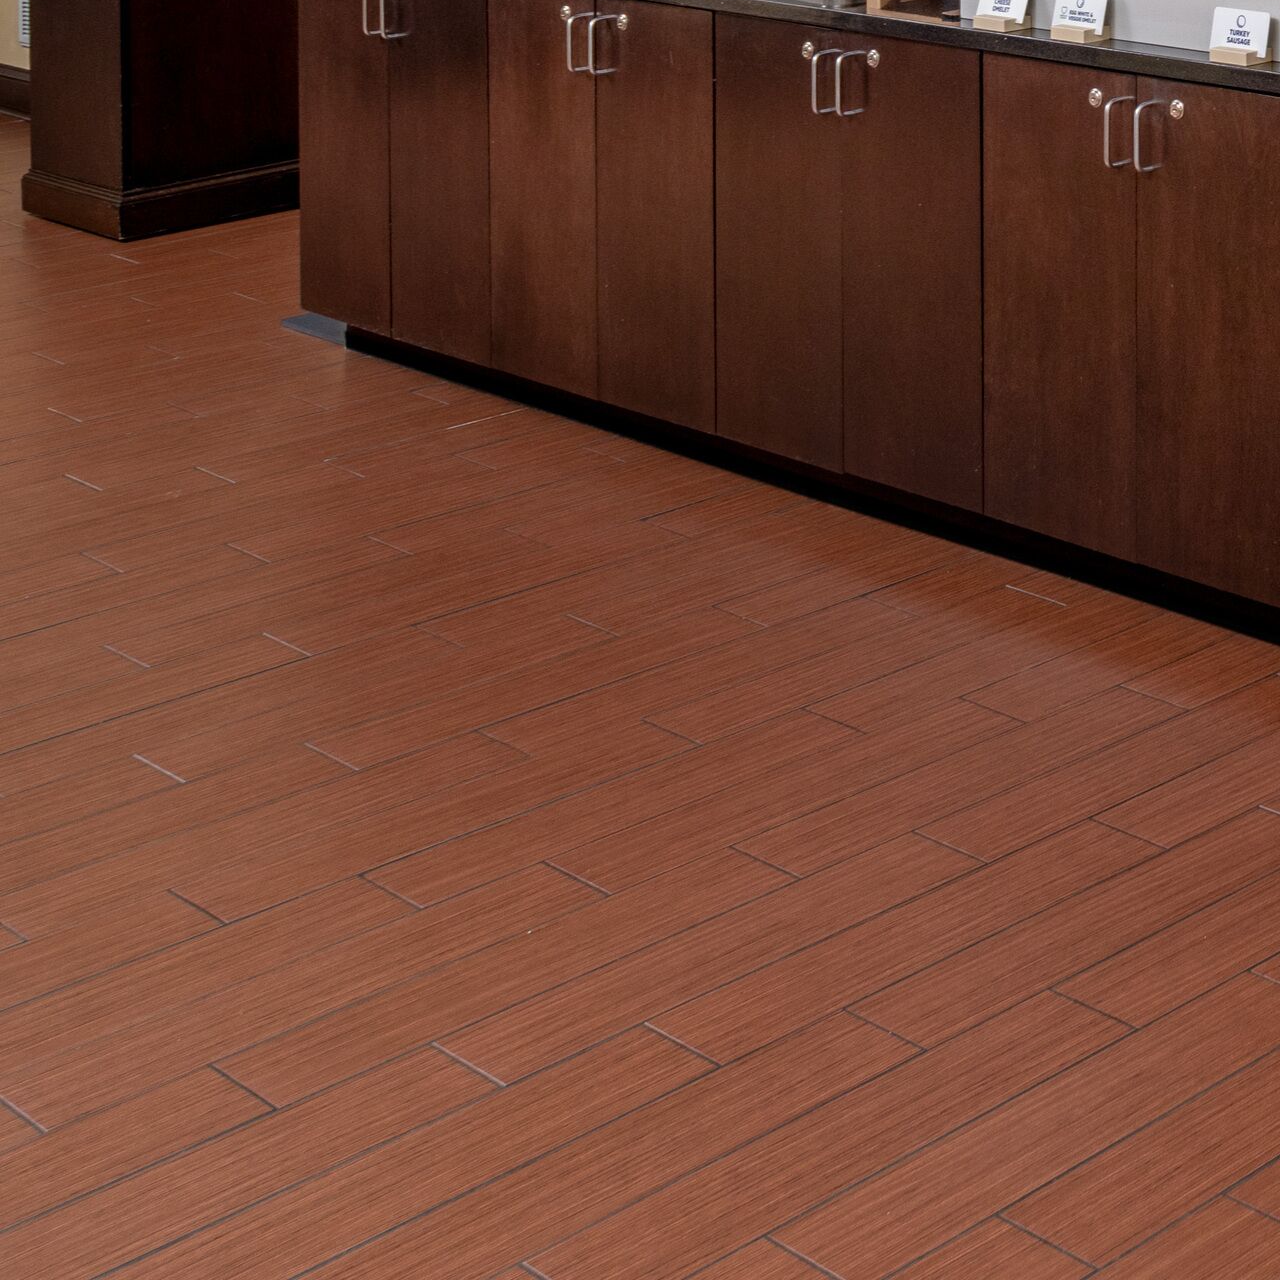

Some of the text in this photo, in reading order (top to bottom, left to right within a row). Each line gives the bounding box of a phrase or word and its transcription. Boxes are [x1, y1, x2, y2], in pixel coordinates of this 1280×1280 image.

[992, 5, 1010, 13] OMELET
[1230, 29, 1250, 37] TURKEY
[1226, 37, 1251, 46] SAUSAGE
